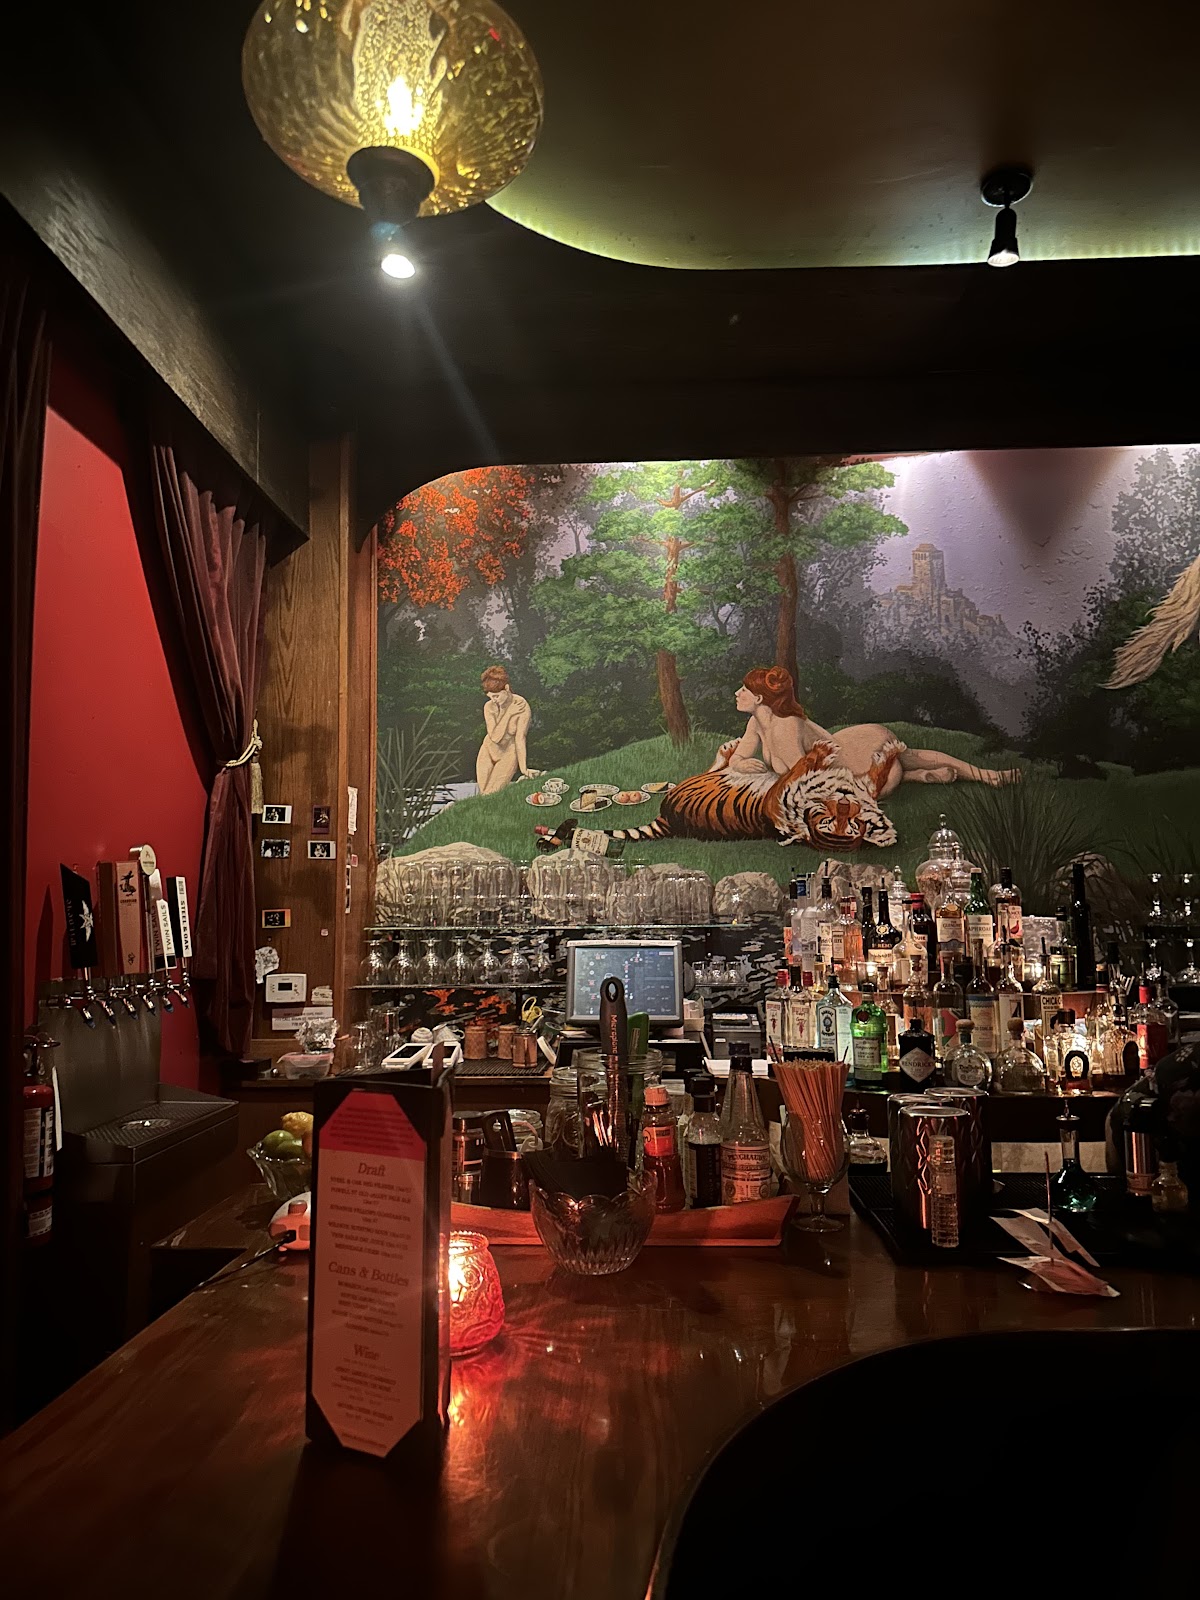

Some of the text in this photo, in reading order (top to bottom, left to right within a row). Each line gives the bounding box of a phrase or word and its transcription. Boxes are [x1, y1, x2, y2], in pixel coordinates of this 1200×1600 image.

[160, 904, 168, 927] SAILS
[358, 1162, 386, 1176] Draft
[328, 1261, 410, 1287] Cans & Bottles
